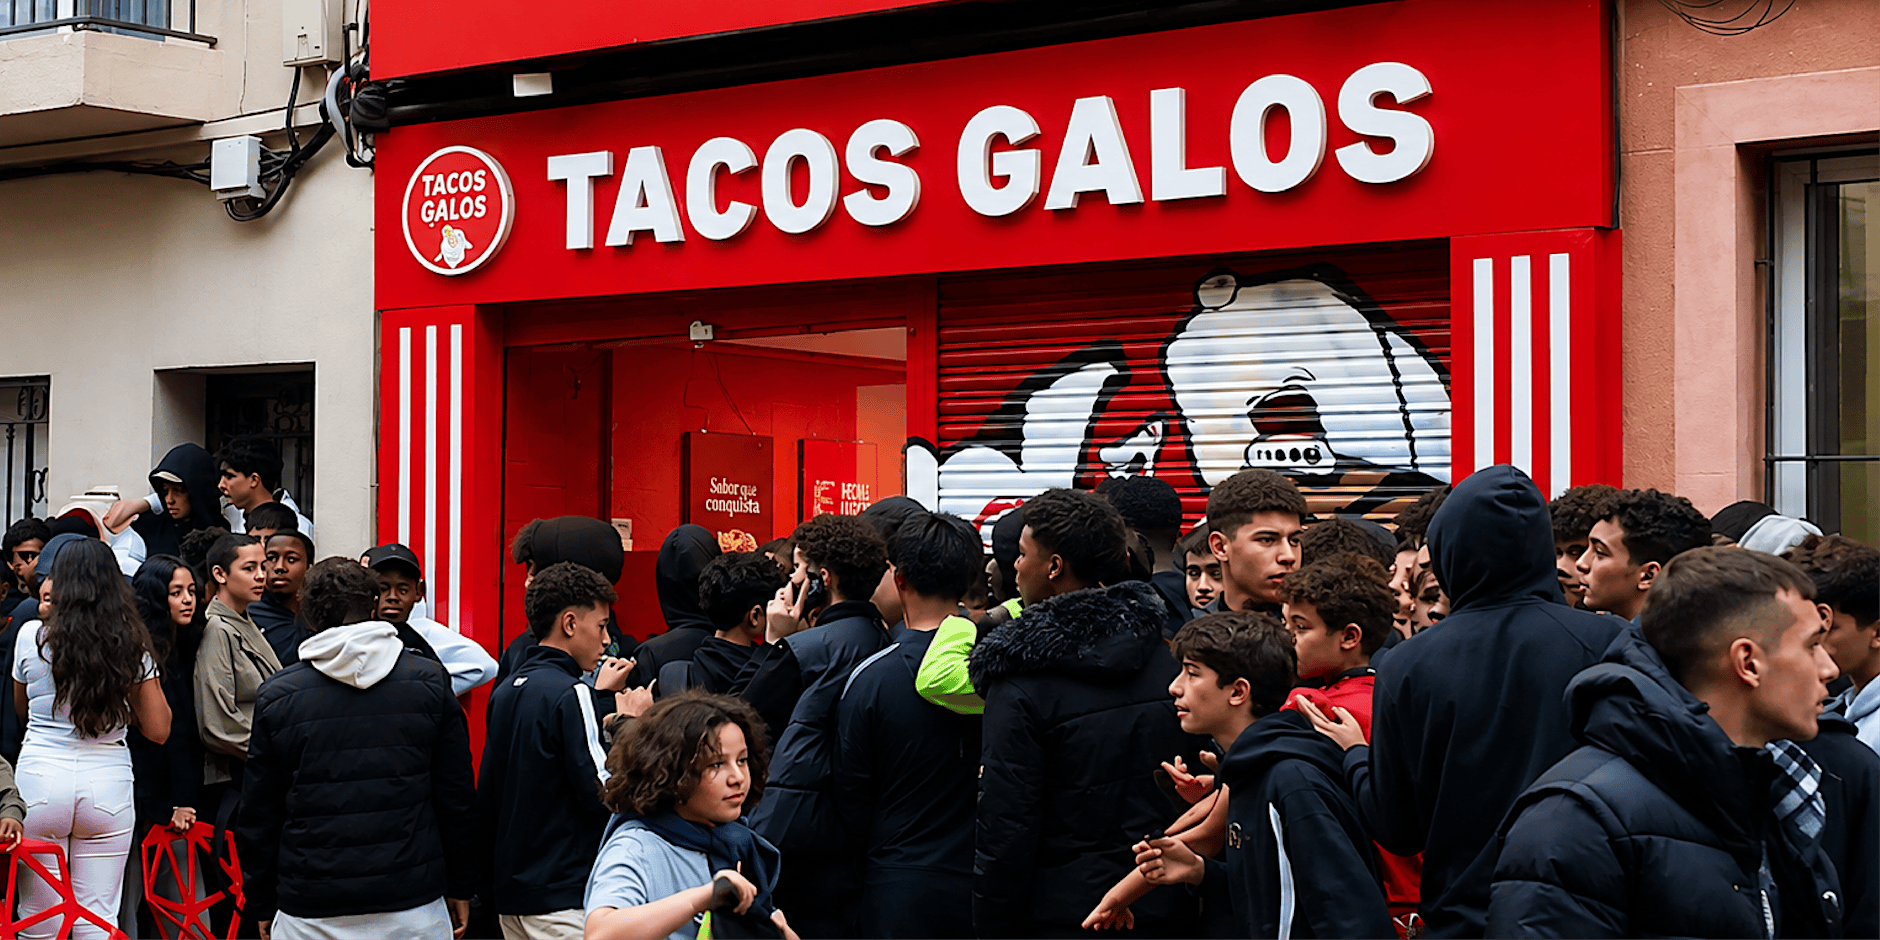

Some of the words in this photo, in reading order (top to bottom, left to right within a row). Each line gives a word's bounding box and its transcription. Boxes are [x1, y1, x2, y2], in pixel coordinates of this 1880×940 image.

[547, 119, 921, 249] TACOS
[957, 61, 1434, 216] GALOS
[421, 168, 487, 197] TACOS
[420, 194, 487, 223] GALOS
[709, 476, 740, 495] Sabor
[705, 496, 760, 517] conquista
